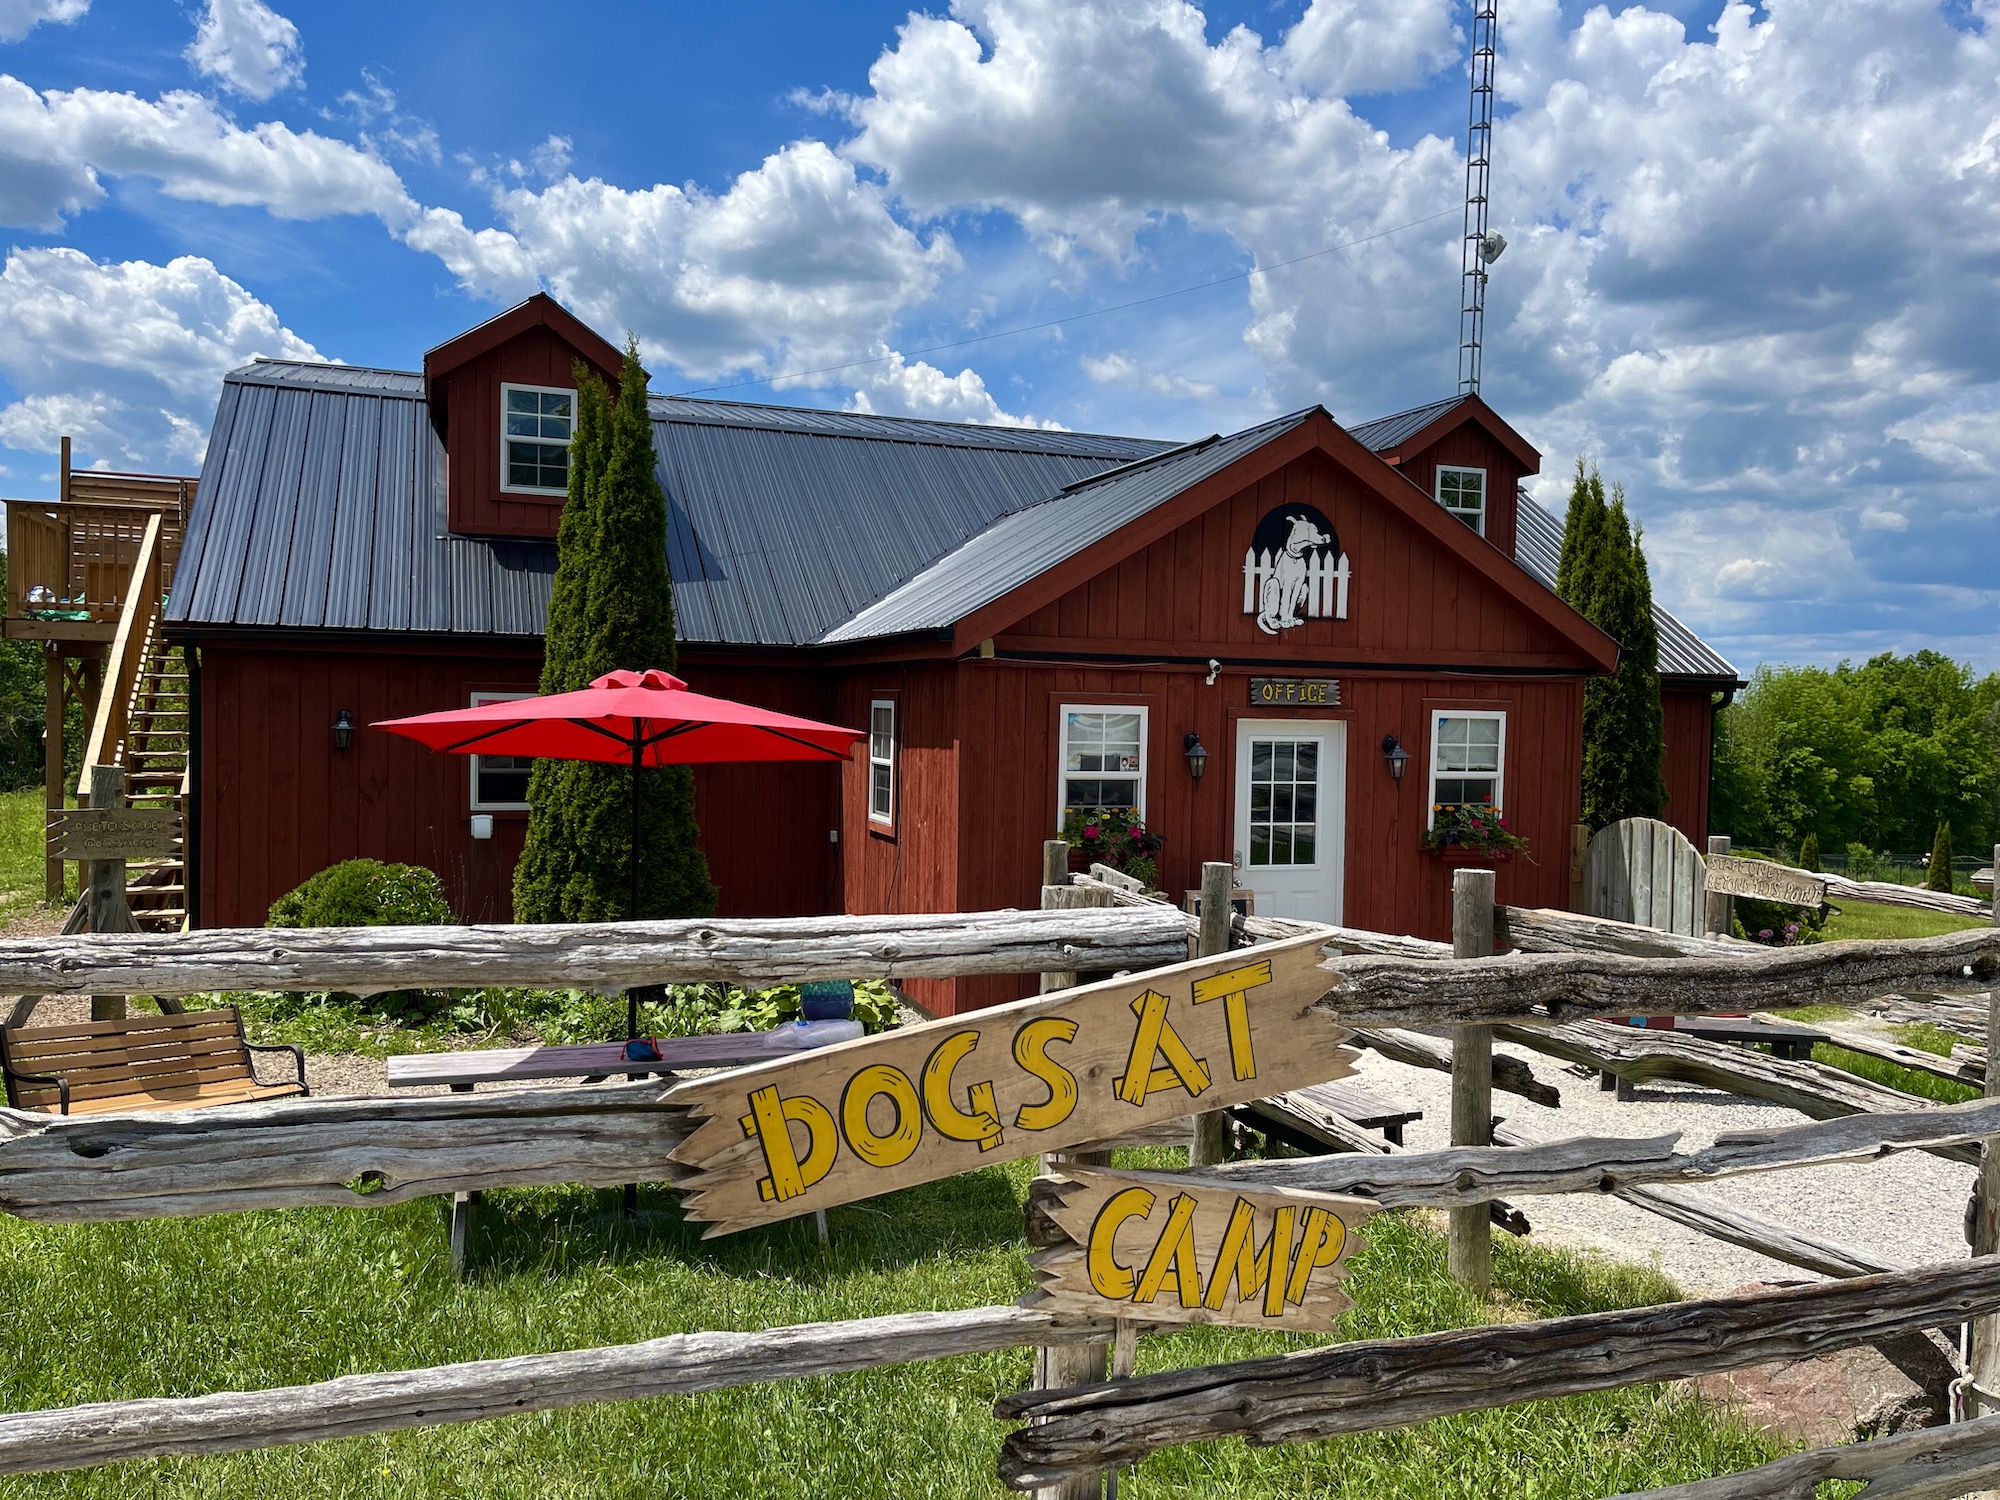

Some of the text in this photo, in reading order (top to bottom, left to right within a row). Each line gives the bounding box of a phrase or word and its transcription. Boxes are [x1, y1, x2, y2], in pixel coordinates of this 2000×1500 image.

[1262, 683, 1329, 703] OFFICE
[75, 820, 167, 832] PHOTO STATION
[1710, 857, 1784, 880] STAFF ONLY
[1708, 874, 1822, 904] BEYOND THIS POINT
[738, 958, 1273, 1203] DOGS AT
[1086, 1187, 1347, 1317] CAMP
